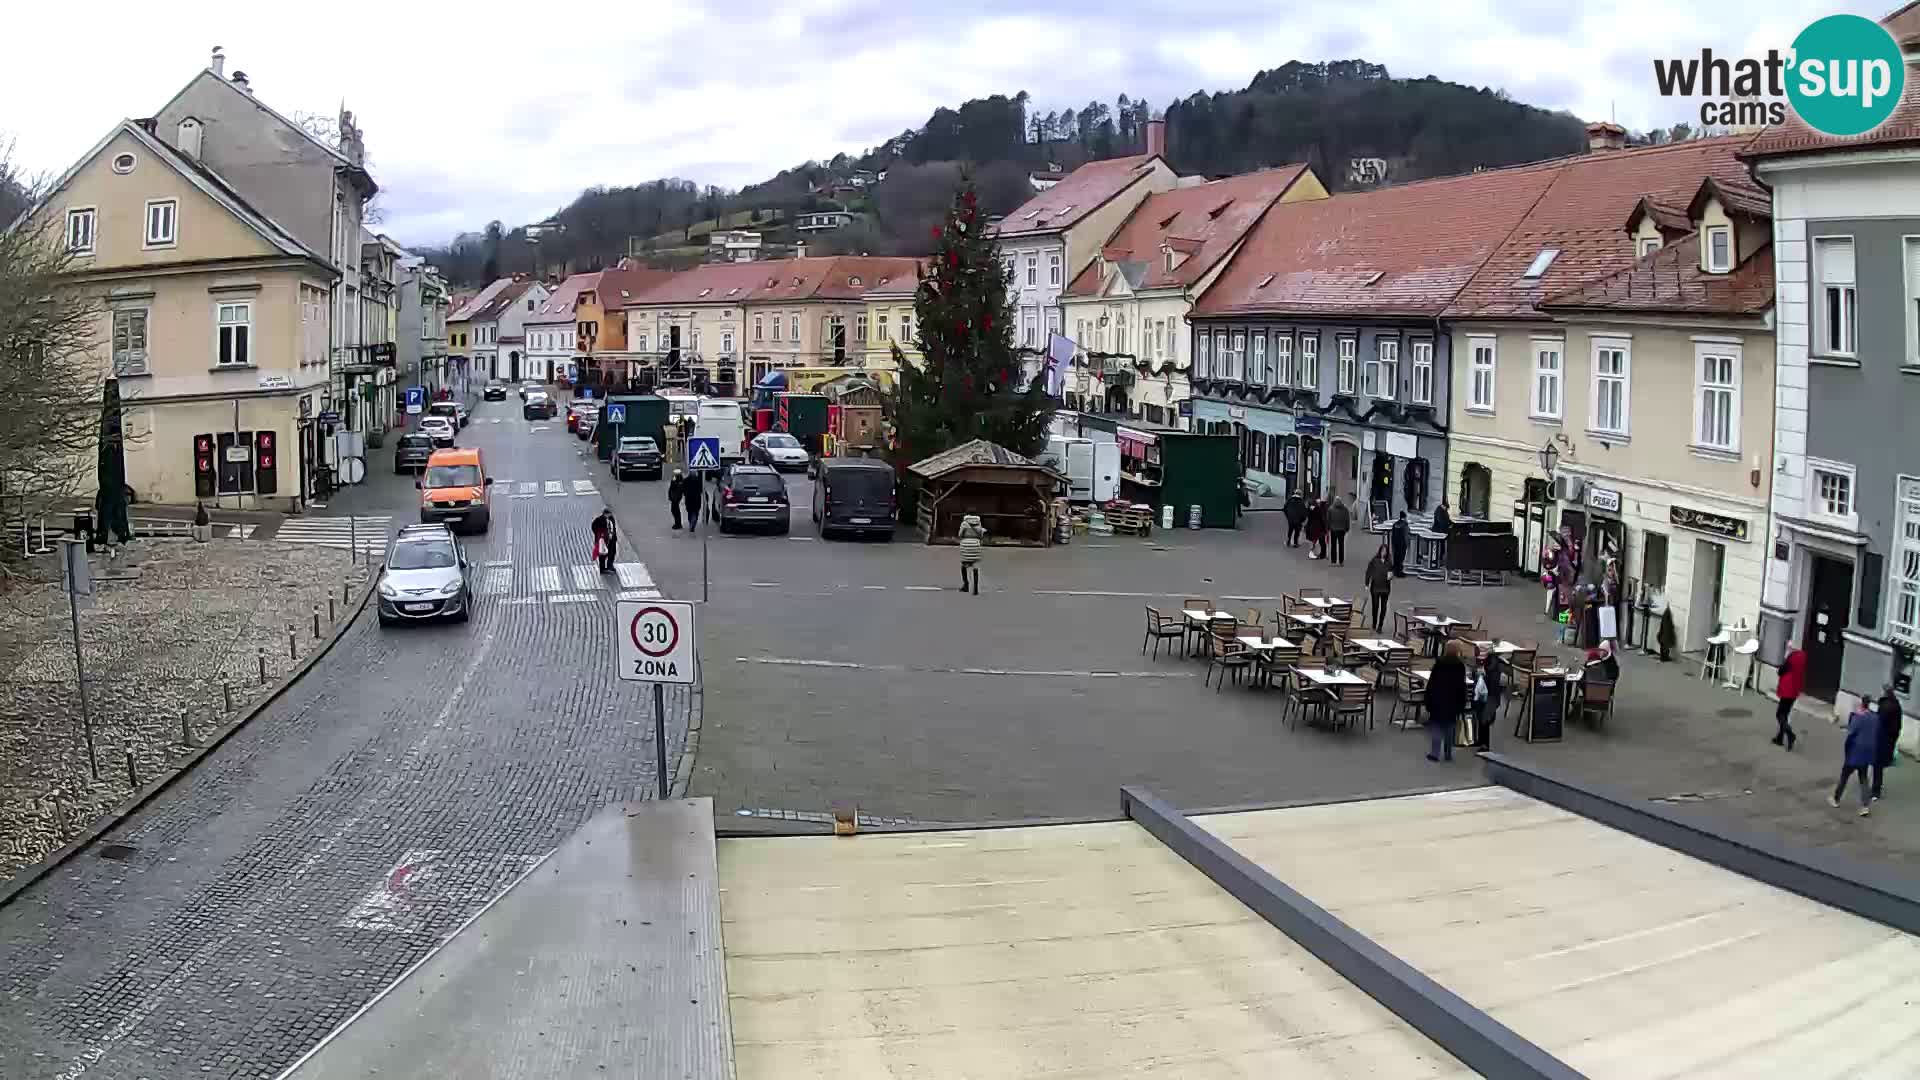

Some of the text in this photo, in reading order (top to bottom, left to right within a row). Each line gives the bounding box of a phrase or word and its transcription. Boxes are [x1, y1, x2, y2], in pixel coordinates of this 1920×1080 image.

[410, 391, 418, 403] P
[643, 622, 668, 643] 30
[633, 659, 679, 677] ZONA
